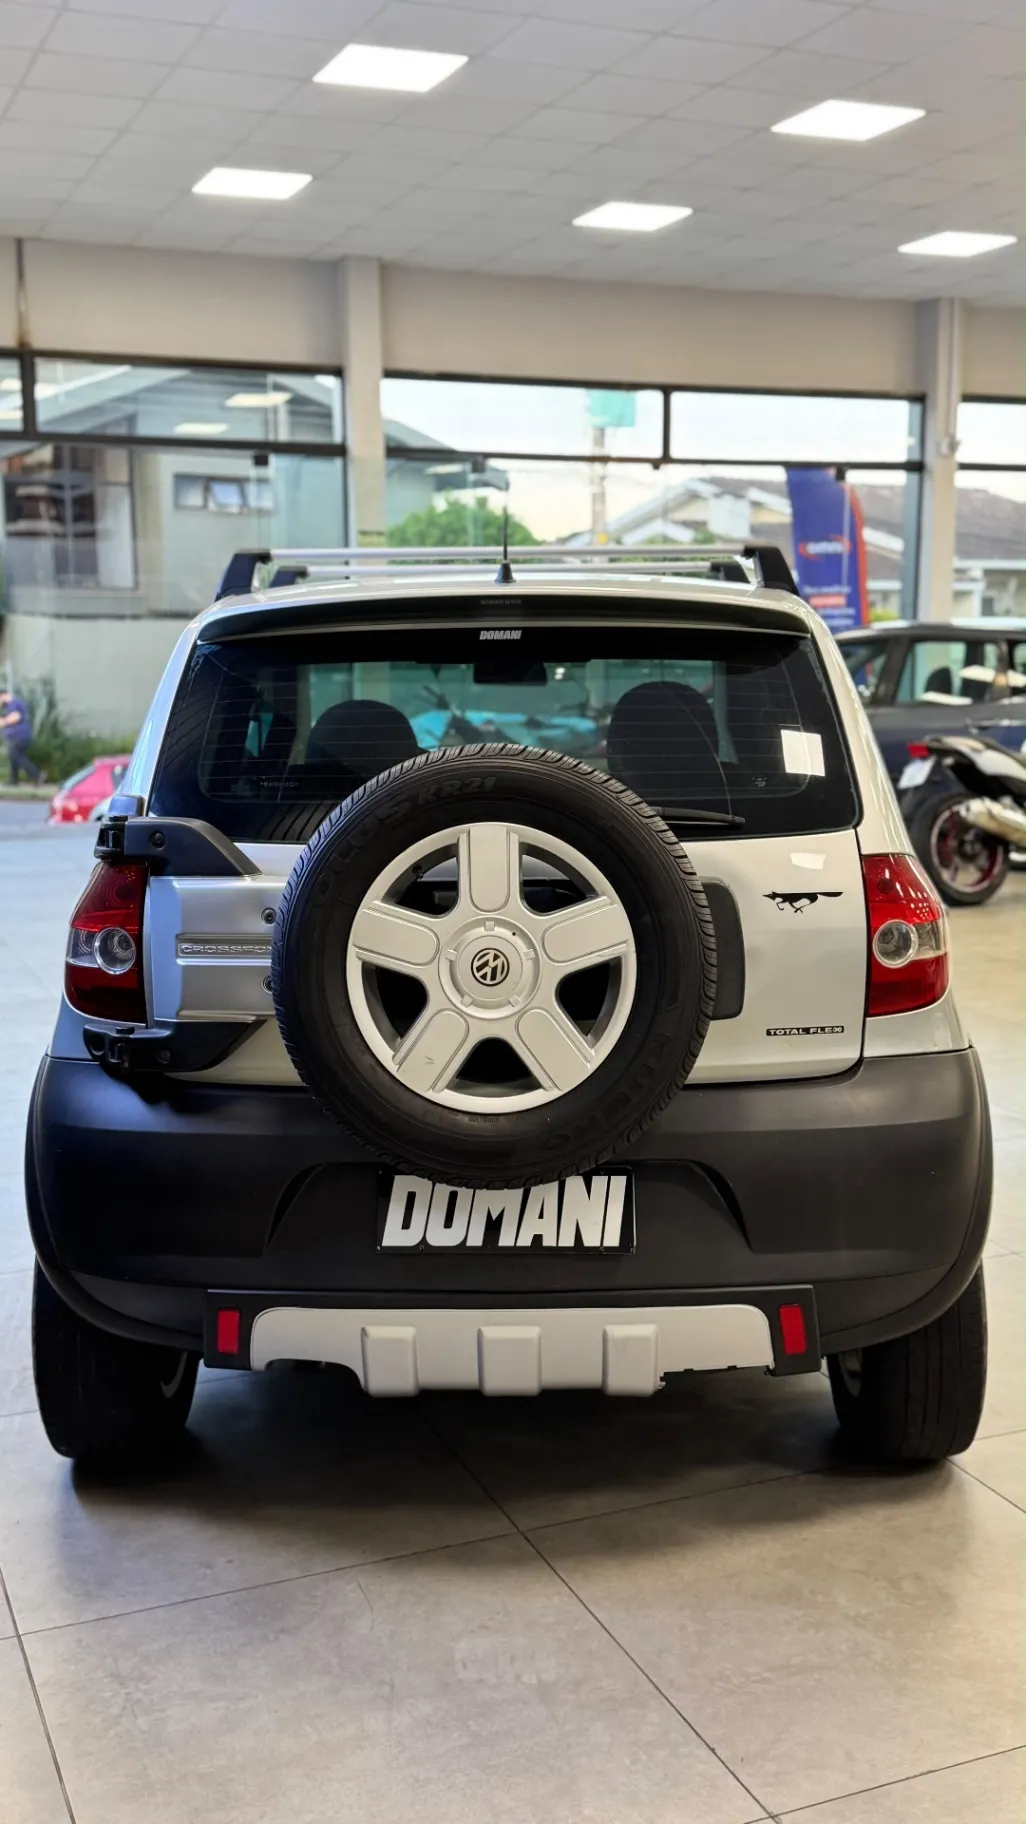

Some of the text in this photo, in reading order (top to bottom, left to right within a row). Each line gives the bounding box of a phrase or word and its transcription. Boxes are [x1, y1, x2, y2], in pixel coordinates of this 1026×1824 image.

[480, 630, 522, 640] DOMANI
[417, 776, 497, 806] KR21
[768, 1026, 843, 1036] TOTAL FLEX
[382, 1174, 627, 1247] DOMANI
